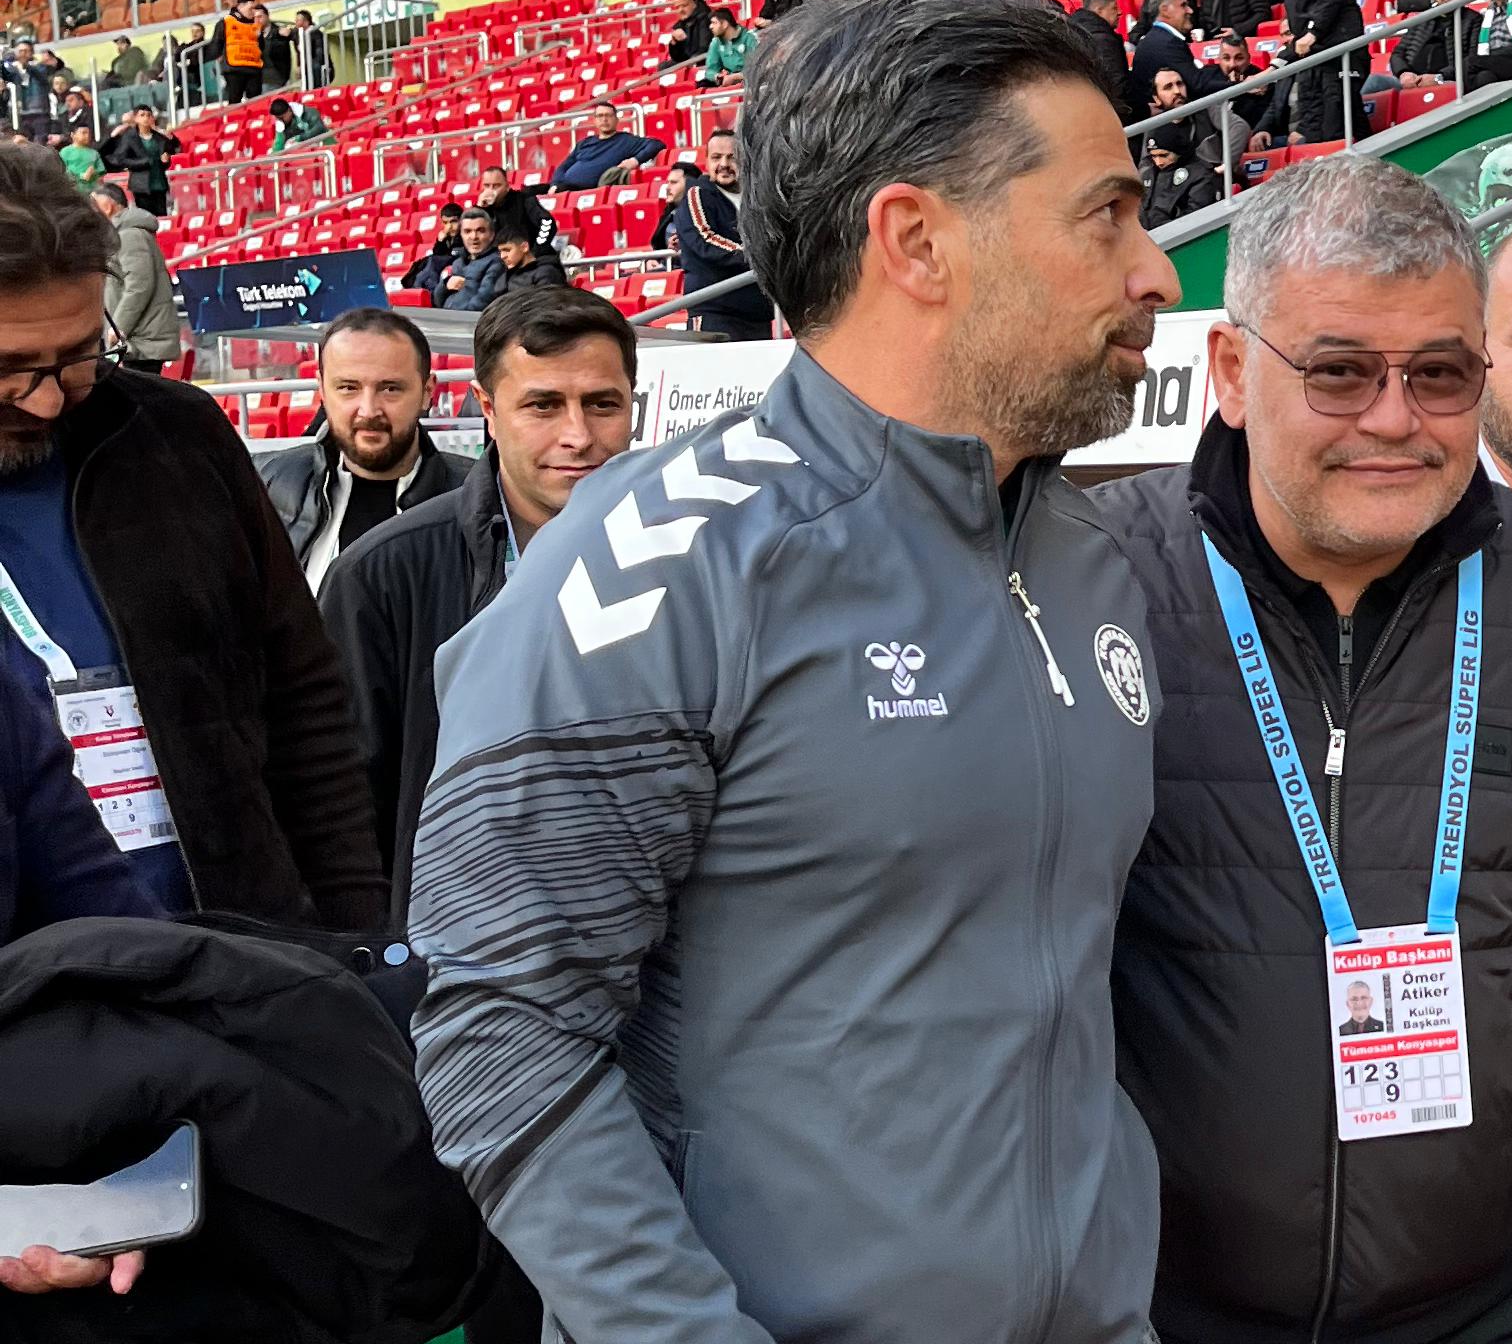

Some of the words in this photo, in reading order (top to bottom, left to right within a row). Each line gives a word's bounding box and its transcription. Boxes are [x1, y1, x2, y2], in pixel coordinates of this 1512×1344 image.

[236, 284, 263, 303] Türk
[261, 282, 307, 301] Telekom
[669, 384, 712, 411] Ömer
[712, 385, 764, 409] Atiker
[1458, 607, 1479, 650] LİG
[1235, 629, 1265, 677] LİG
[867, 693, 949, 721] hummel
[1453, 655, 1480, 736] SÜPER
[1245, 681, 1291, 759] SÜPER
[1438, 739, 1473, 876] TRENDYOL
[1279, 760, 1337, 896] TRENDYOL
[1335, 953, 1382, 970] Kulüp
[1386, 947, 1452, 966] Başkanı
[1402, 970, 1446, 985] Ömer
[1401, 986, 1450, 1001] Atiker
[1403, 1017, 1451, 1030] Başkanı
[1409, 1007, 1443, 1018] Kulüp
[1341, 1043, 1394, 1057] Tümosan
[1397, 1035, 1457, 1052] Konyaspor
[1345, 1066, 1356, 1084] 1
[1364, 1063, 1379, 1082] 2
[1384, 1061, 1399, 1080] 3
[1386, 1083, 1400, 1103] 9
[1353, 1110, 1397, 1124] 107045
